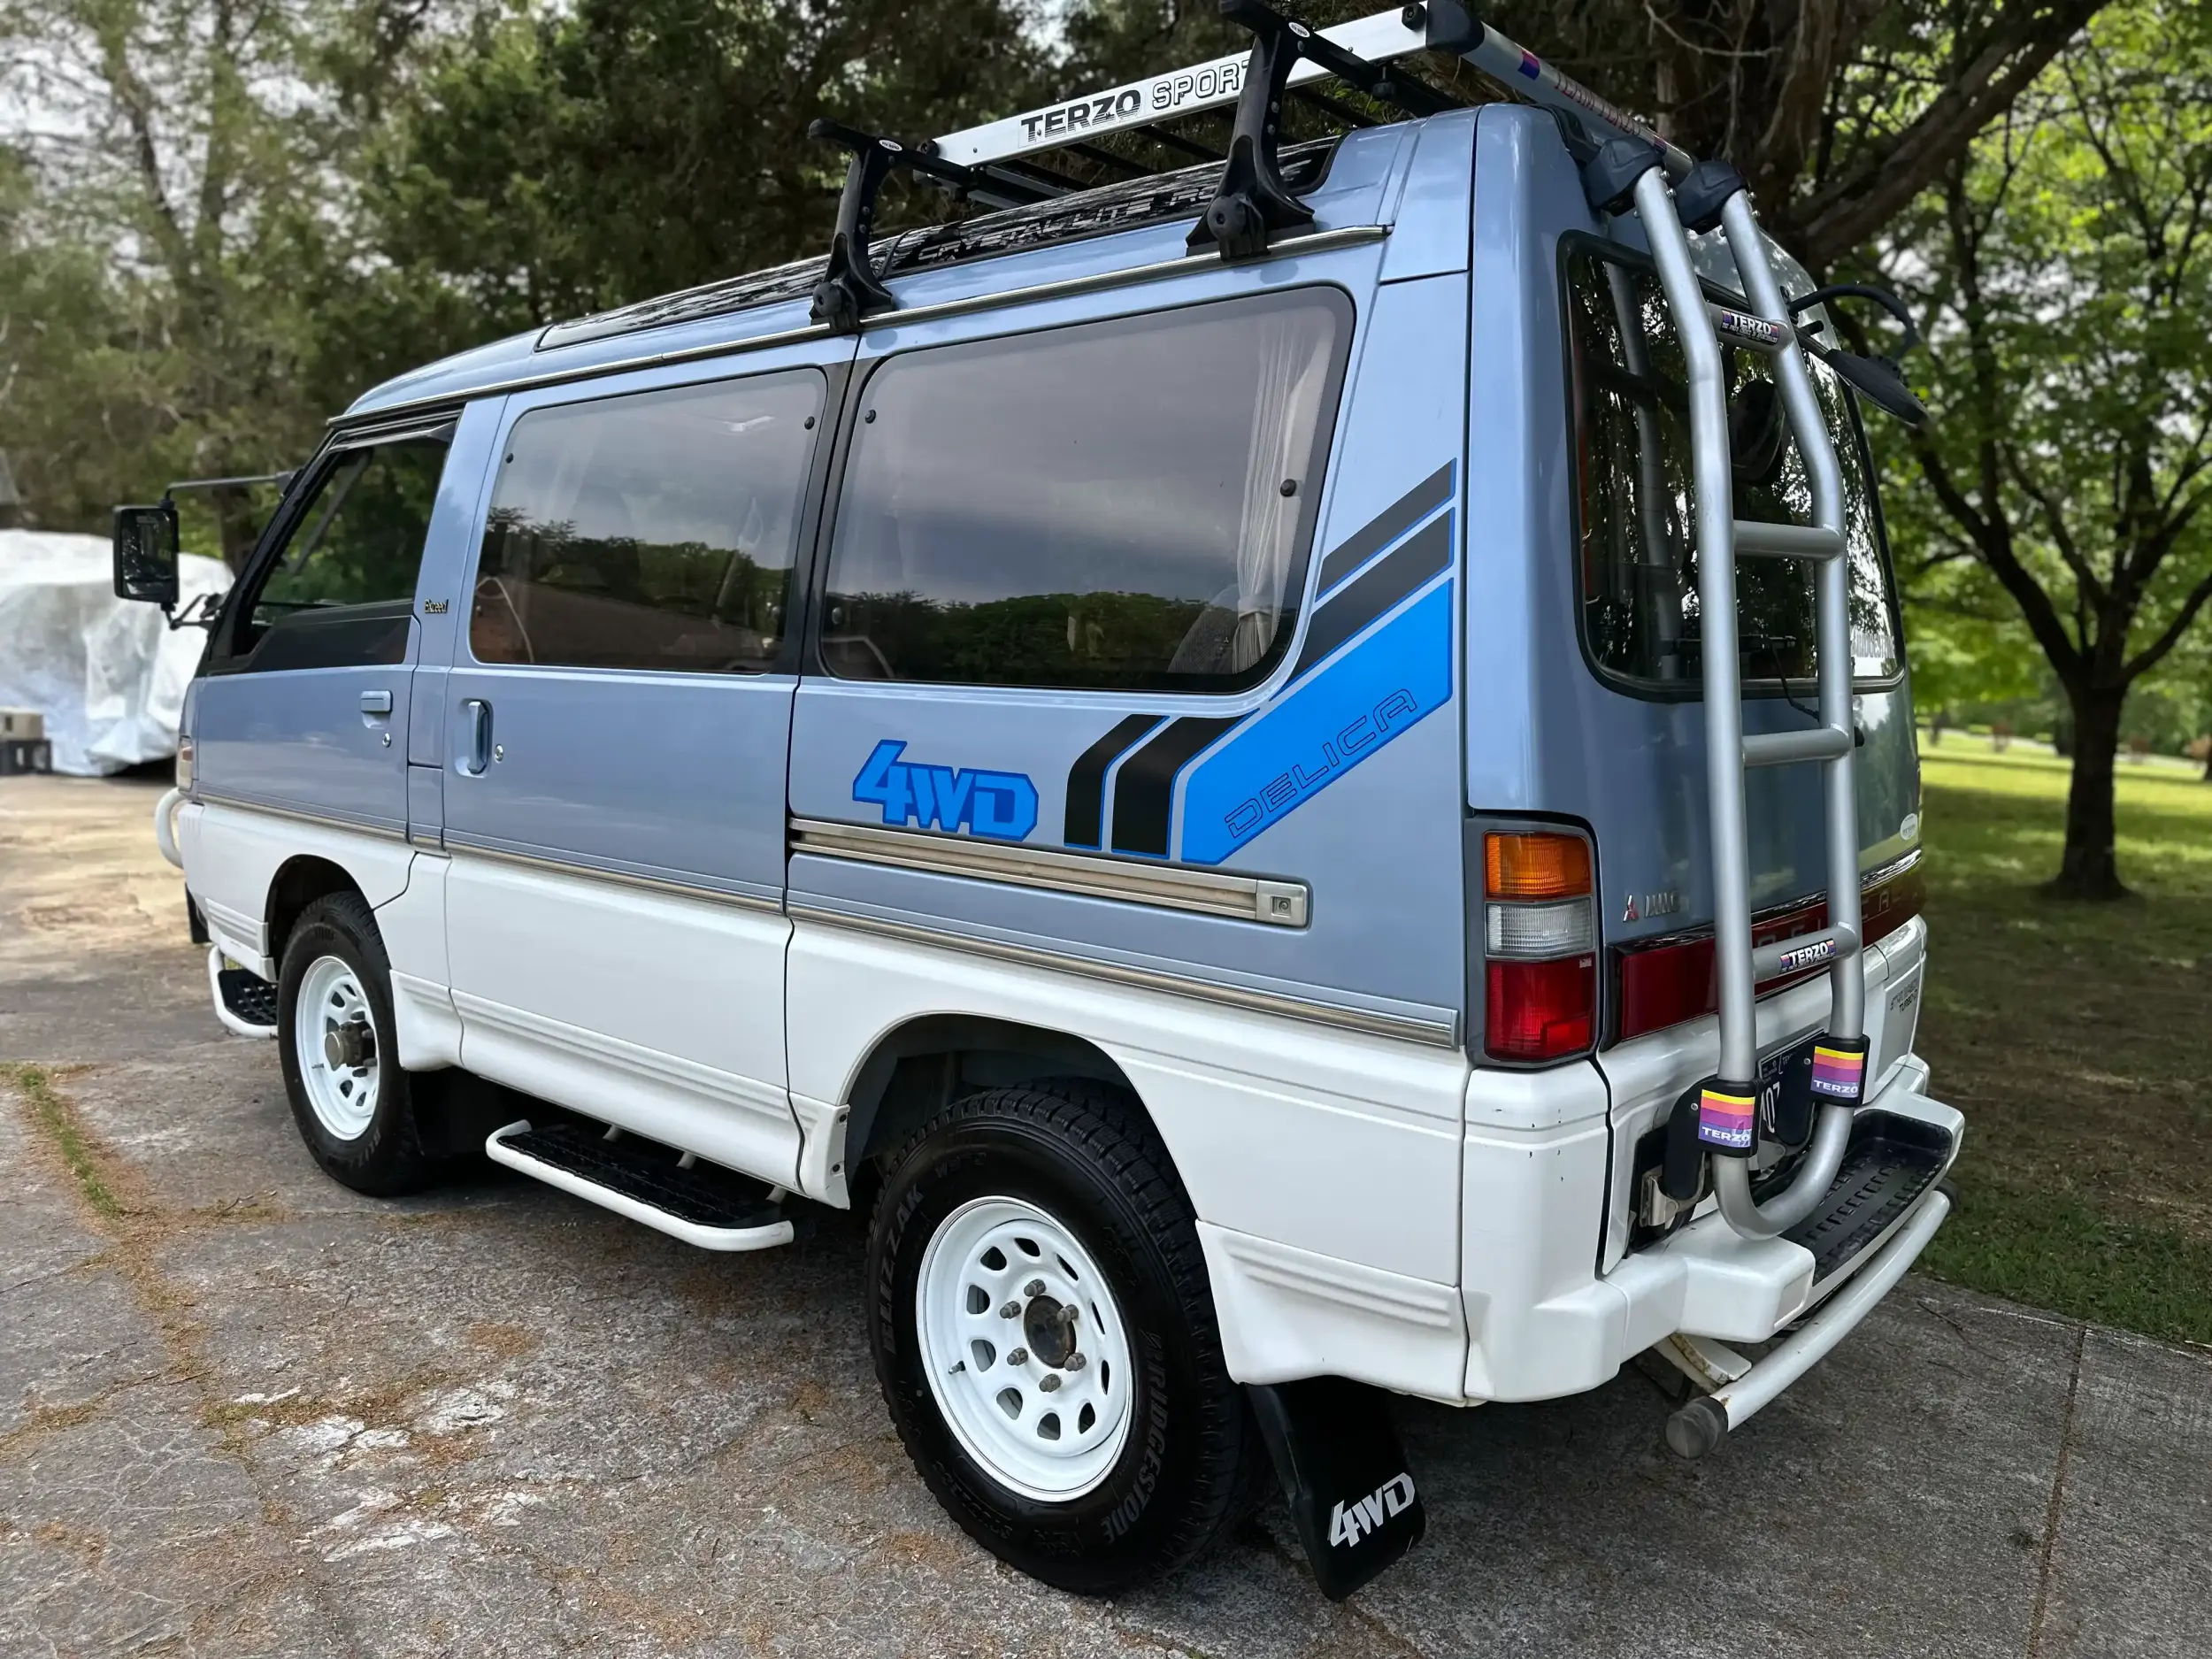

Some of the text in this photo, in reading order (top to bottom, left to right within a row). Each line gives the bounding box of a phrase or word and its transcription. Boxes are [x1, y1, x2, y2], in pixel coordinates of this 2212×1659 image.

[1021, 89, 1141, 142] TERZO
[1071, 196, 1155, 227] LITE
[1731, 311, 1771, 335] TERZO
[1225, 687, 1417, 839] DELICA
[852, 739, 1040, 842] 4WD
[1788, 941, 1829, 965] TERZO
[1813, 1079, 1858, 1094] TERZO
[1701, 1126, 1751, 1142] TERZO
[1328, 1471, 1416, 1548] 4WD
